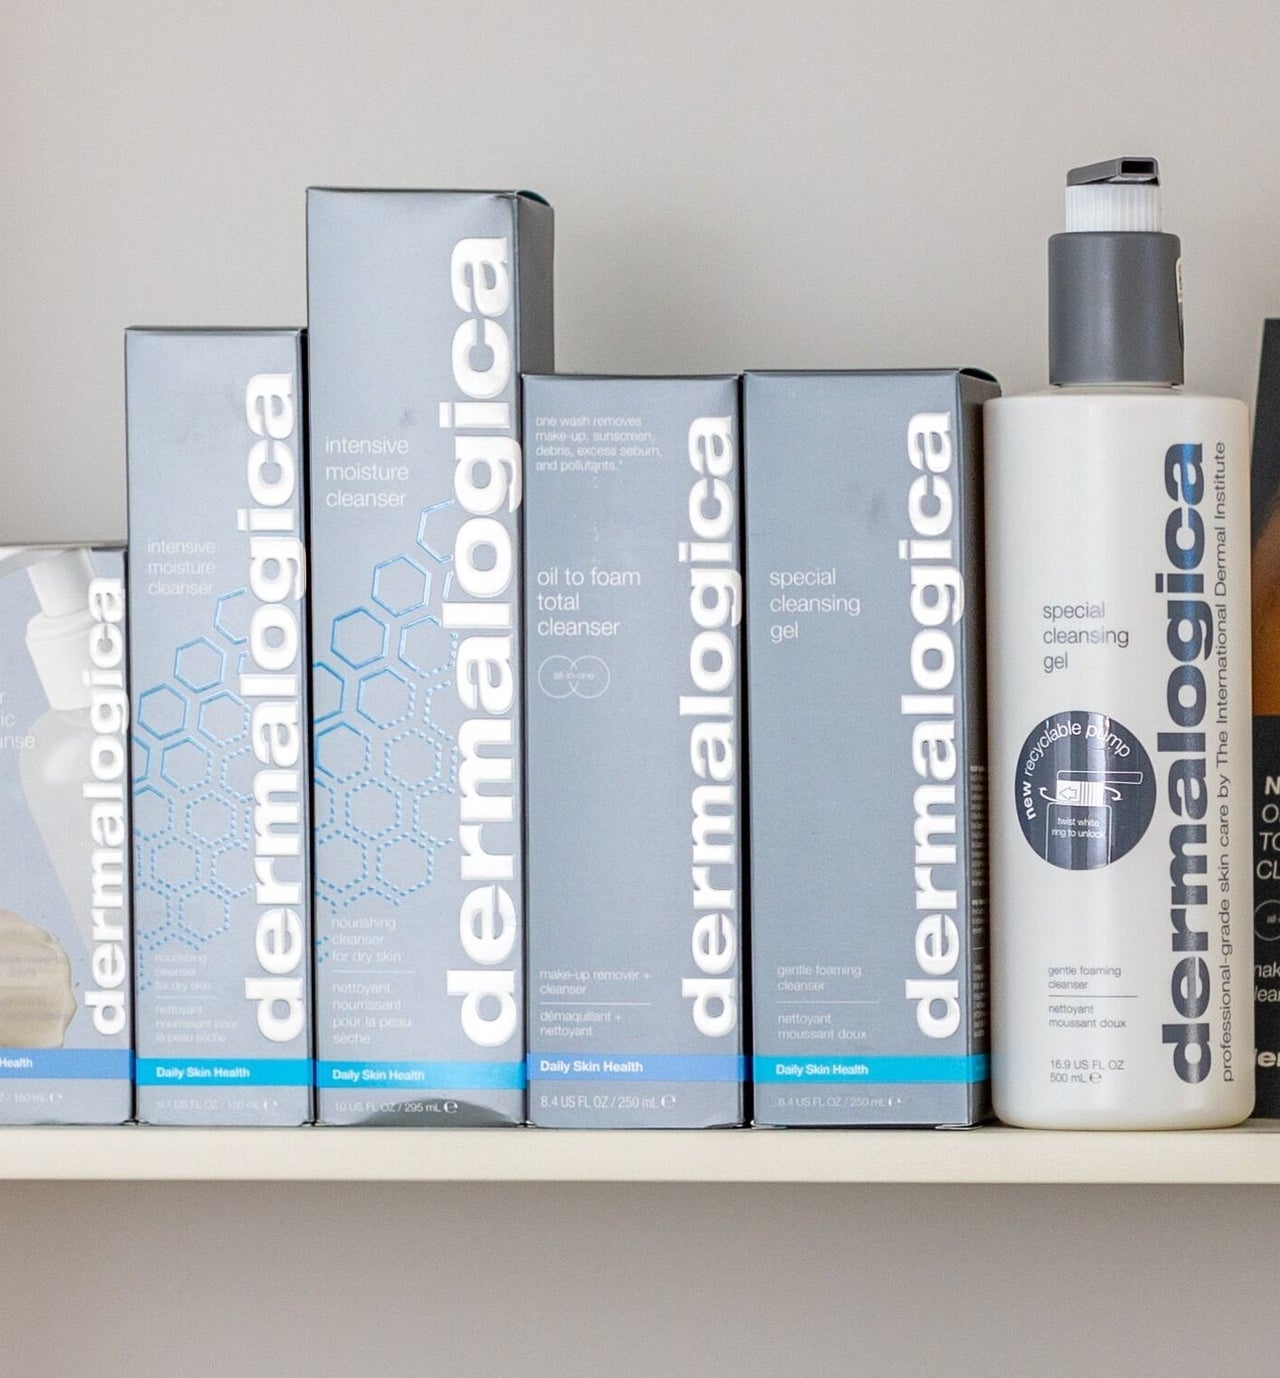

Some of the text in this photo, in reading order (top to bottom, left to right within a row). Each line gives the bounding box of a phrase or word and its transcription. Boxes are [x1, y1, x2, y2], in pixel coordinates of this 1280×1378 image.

[536, 416, 641, 427] one wash removes
[325, 437, 409, 454] intensive
[536, 431, 655, 443] make-up, sunscreen,
[326, 465, 409, 481] moisture
[326, 491, 405, 507] cleanser
[537, 568, 641, 586] oil to foam
[770, 570, 835, 588] special
[538, 593, 579, 611] total
[770, 595, 860, 616] cleansing
[538, 619, 619, 636] cleanser
[771, 621, 798, 643] gel
[439, 236, 522, 1047] dermalogica
[237, 373, 306, 1044] dermalogica
[678, 415, 741, 1038] dermalogica
[899, 411, 964, 1039] dermalogica
[1023, 720, 1130, 820] new recyclable pump
[1155, 443, 1213, 1084] dermalogica
[1214, 442, 1232, 1082] professional-grade skin care by The International Dermal Institute
[83, 577, 128, 1035] dermalogica
[541, 1060, 643, 1075] Daily Skin Health
